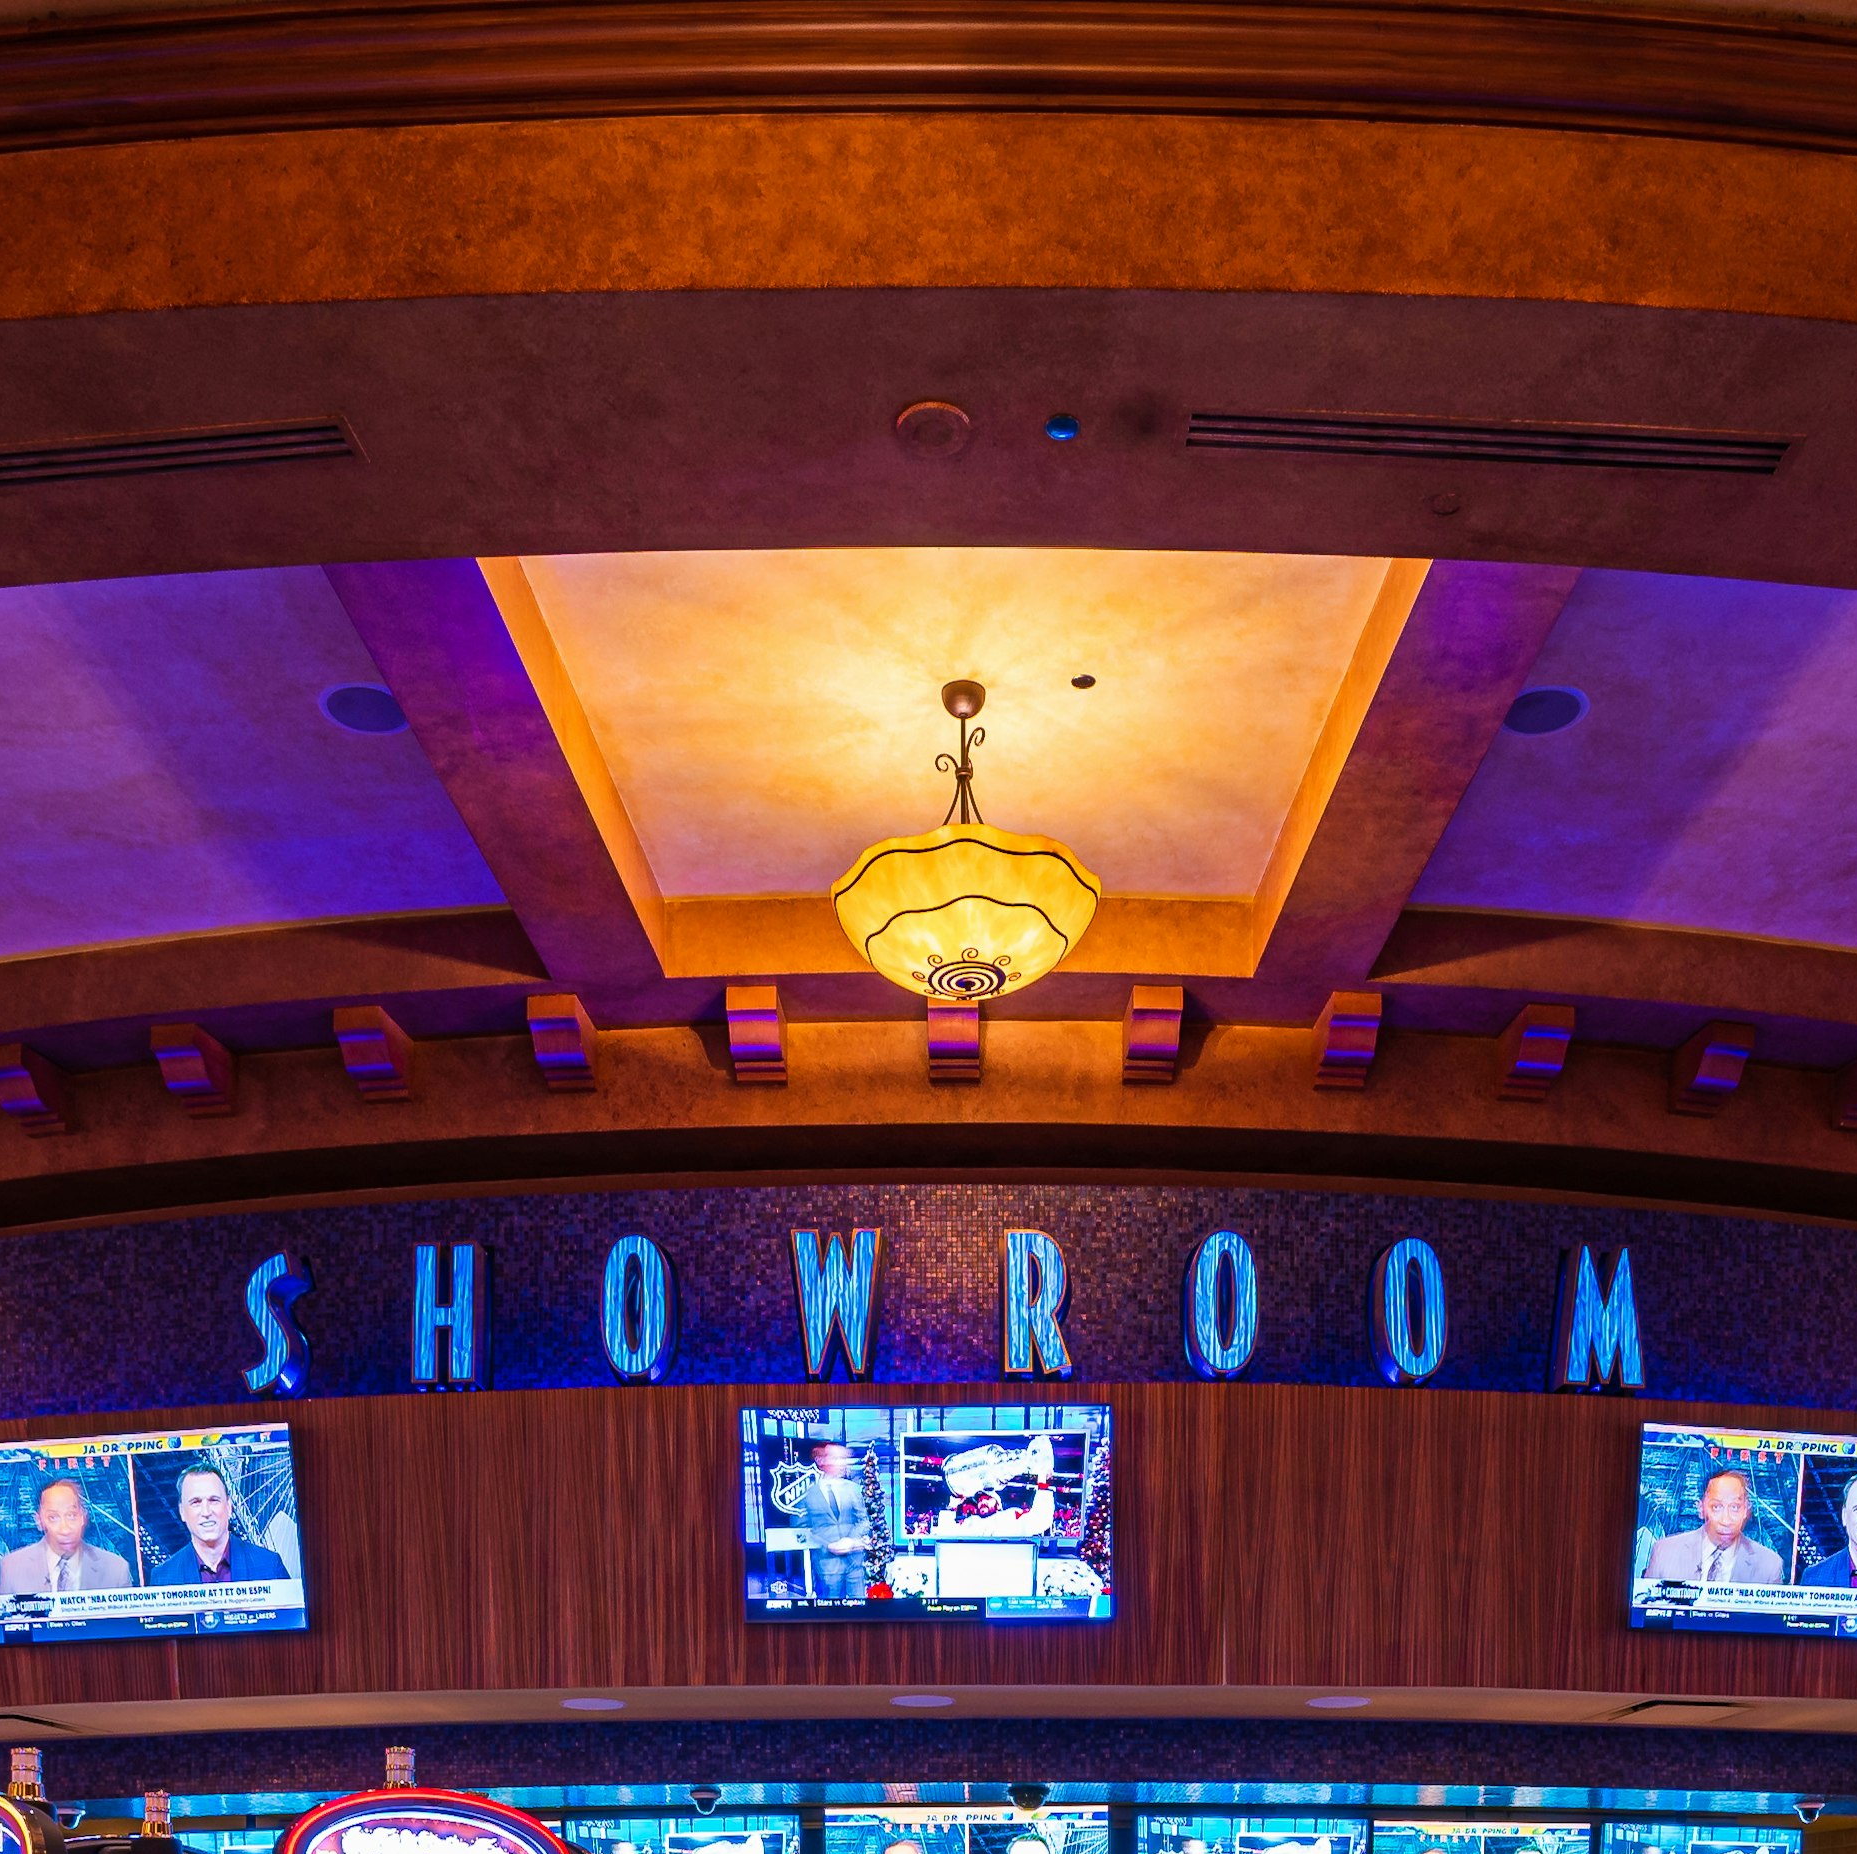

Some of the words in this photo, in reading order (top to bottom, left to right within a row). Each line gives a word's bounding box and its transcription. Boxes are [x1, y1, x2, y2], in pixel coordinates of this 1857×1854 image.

[241, 1229, 1645, 1394] SHOWROOM
[60, 1596, 86, 1605] WATCH
[161, 1589, 207, 1601] TOMORROW
[208, 1589, 218, 1598] AT
[225, 1588, 235, 1597] ET
[236, 1587, 247, 1596] ON
[1708, 1588, 1734, 1597] WATCH
[1809, 1591, 1853, 1602] TOMORROW
